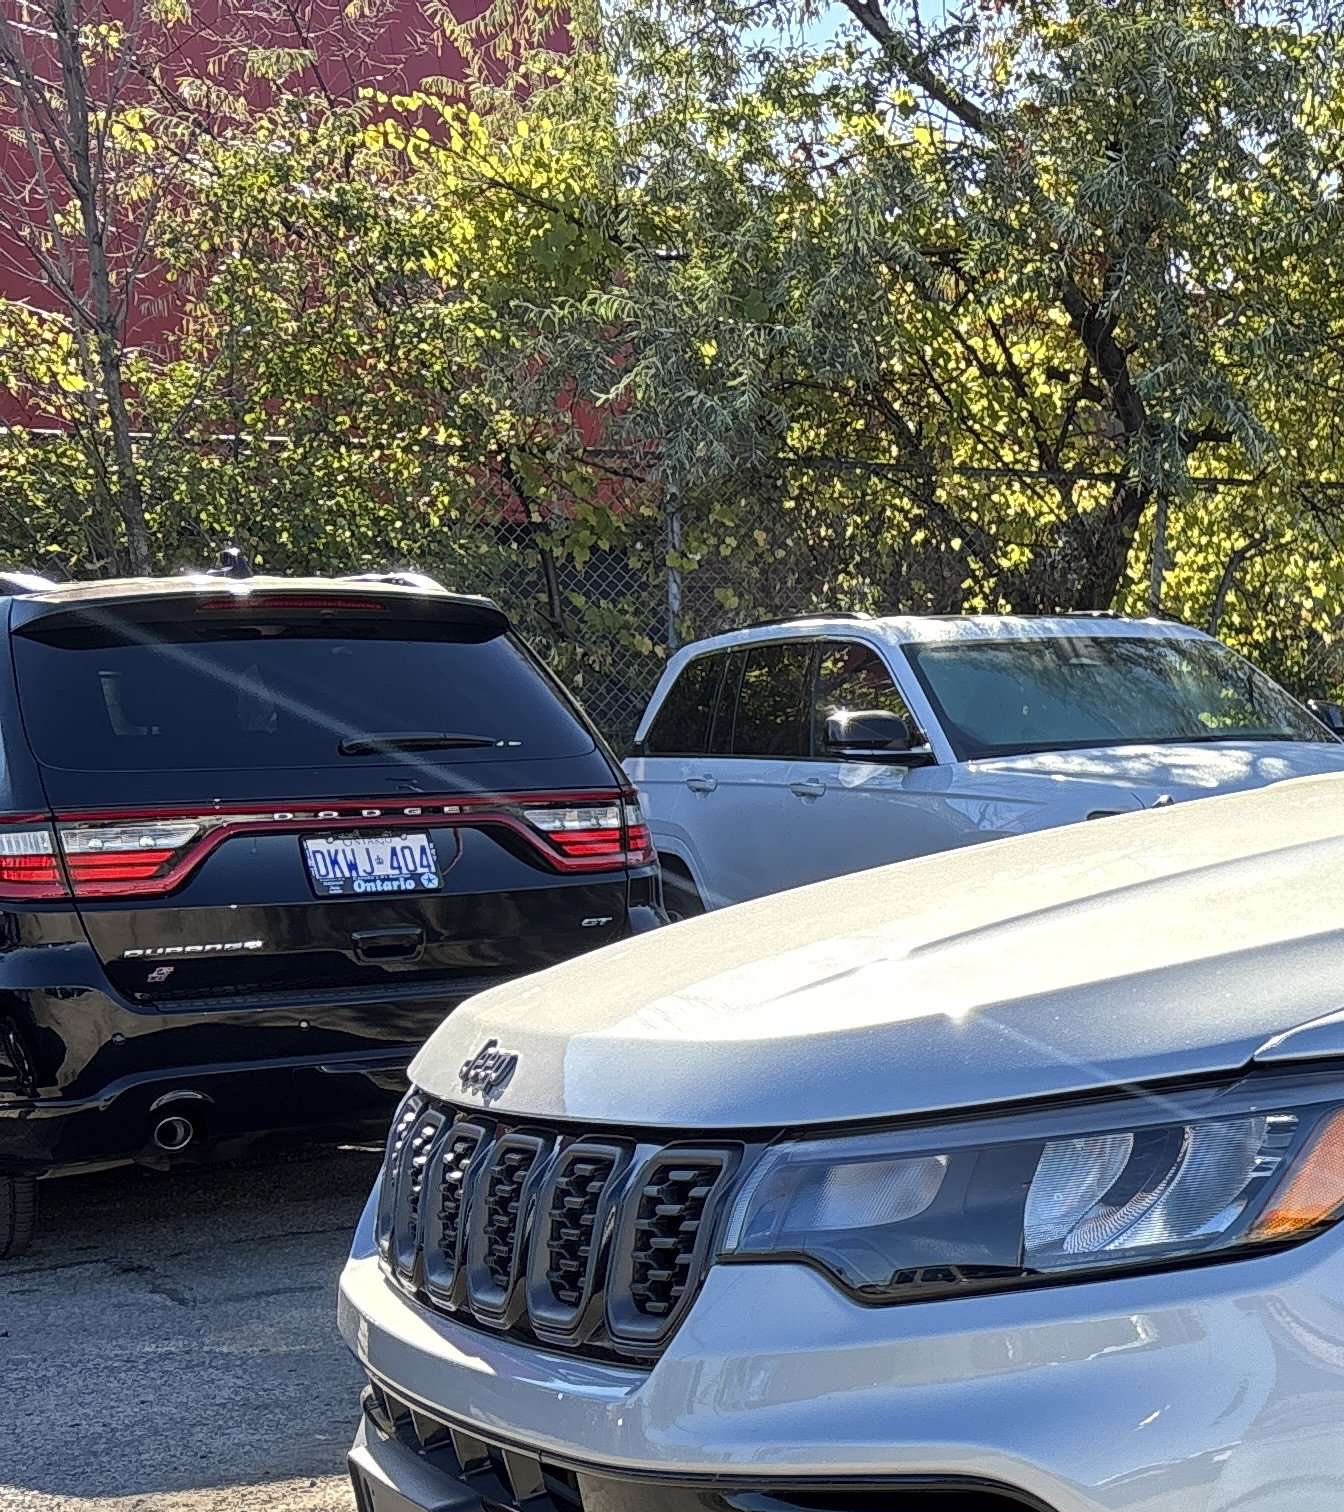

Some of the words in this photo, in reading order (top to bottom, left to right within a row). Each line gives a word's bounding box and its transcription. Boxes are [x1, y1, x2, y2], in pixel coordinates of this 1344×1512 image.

[273, 805, 461, 821] DODGE
[311, 847, 375, 878] DKWJ
[389, 844, 433, 873] 404
[353, 877, 416, 893] Ontario
[581, 916, 613, 926] GT
